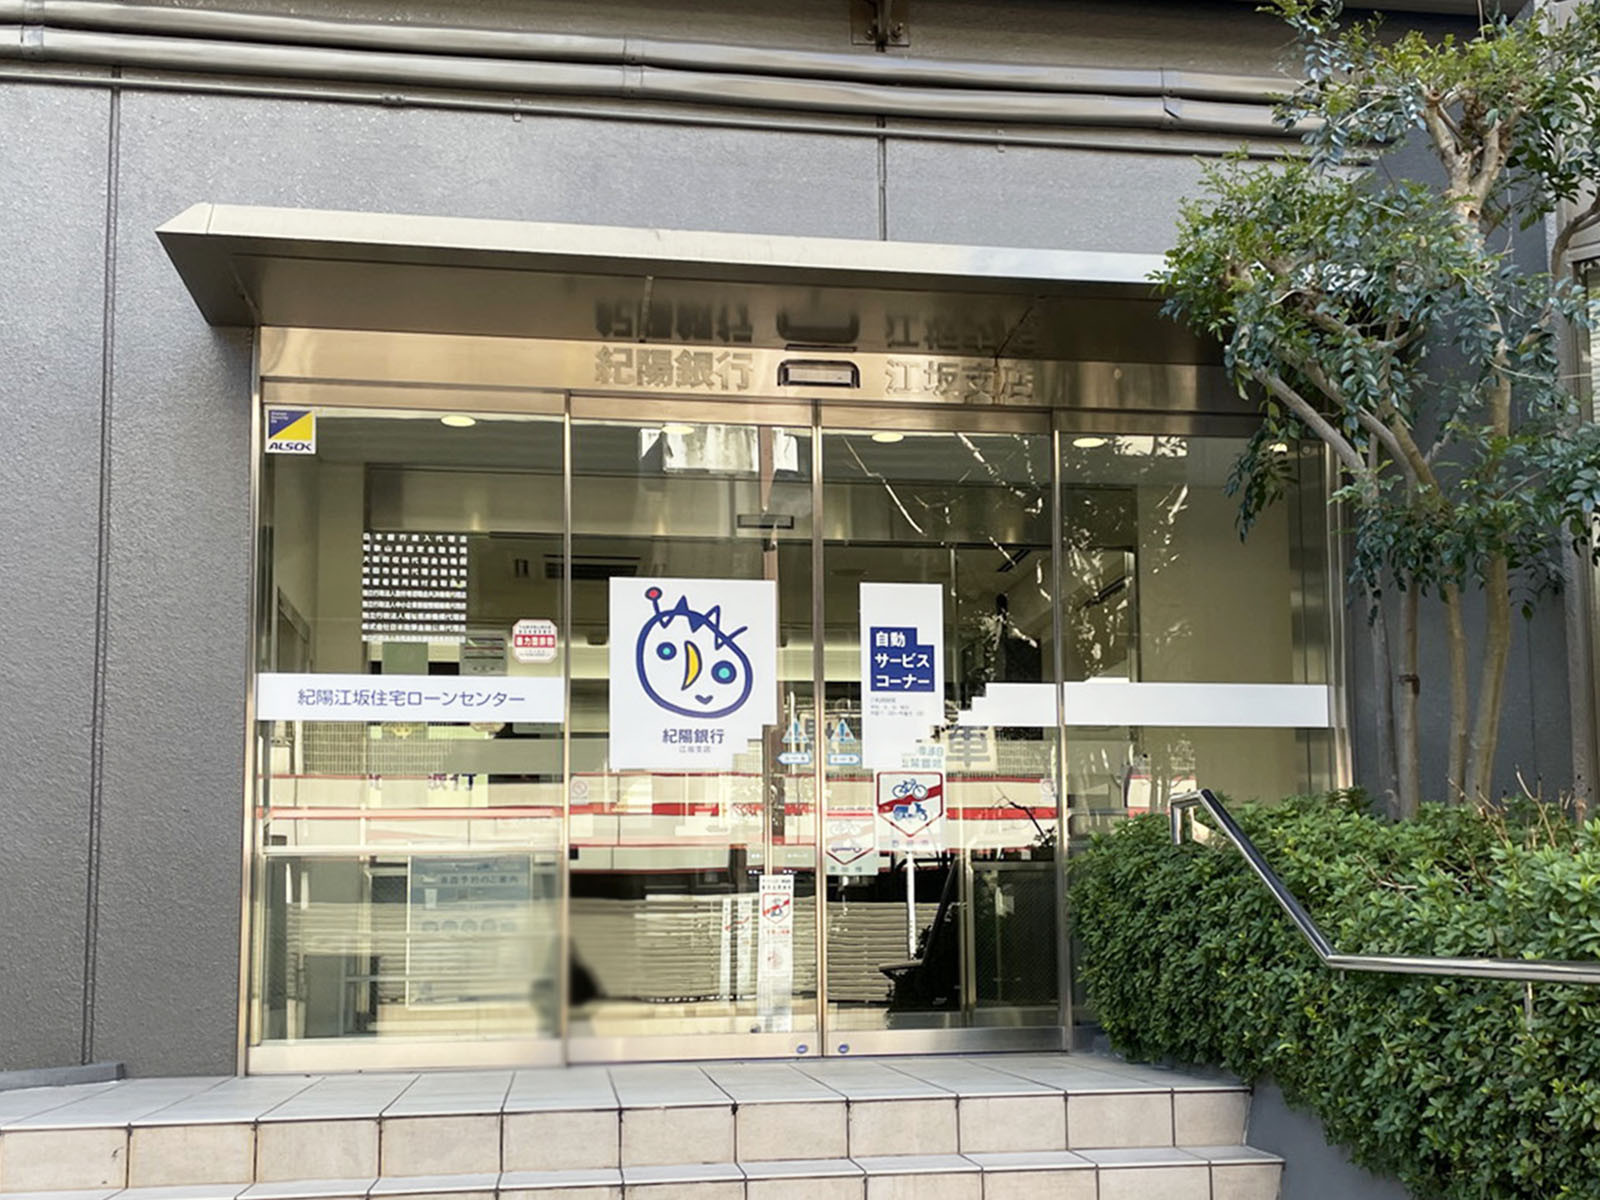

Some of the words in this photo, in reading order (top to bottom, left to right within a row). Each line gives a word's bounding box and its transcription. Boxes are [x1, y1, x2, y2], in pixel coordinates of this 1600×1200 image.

[594, 345, 753, 391] 紀陽銀行
[884, 358, 1034, 404] 江坂支店
[269, 442, 312, 451] ALSOK
[876, 631, 906, 648] 自動
[875, 652, 930, 669] サービス
[876, 673, 930, 689] コーナー
[298, 688, 525, 707] 紀陽江坂住宅ローンセンター
[662, 728, 724, 744] 紀陽銀行
